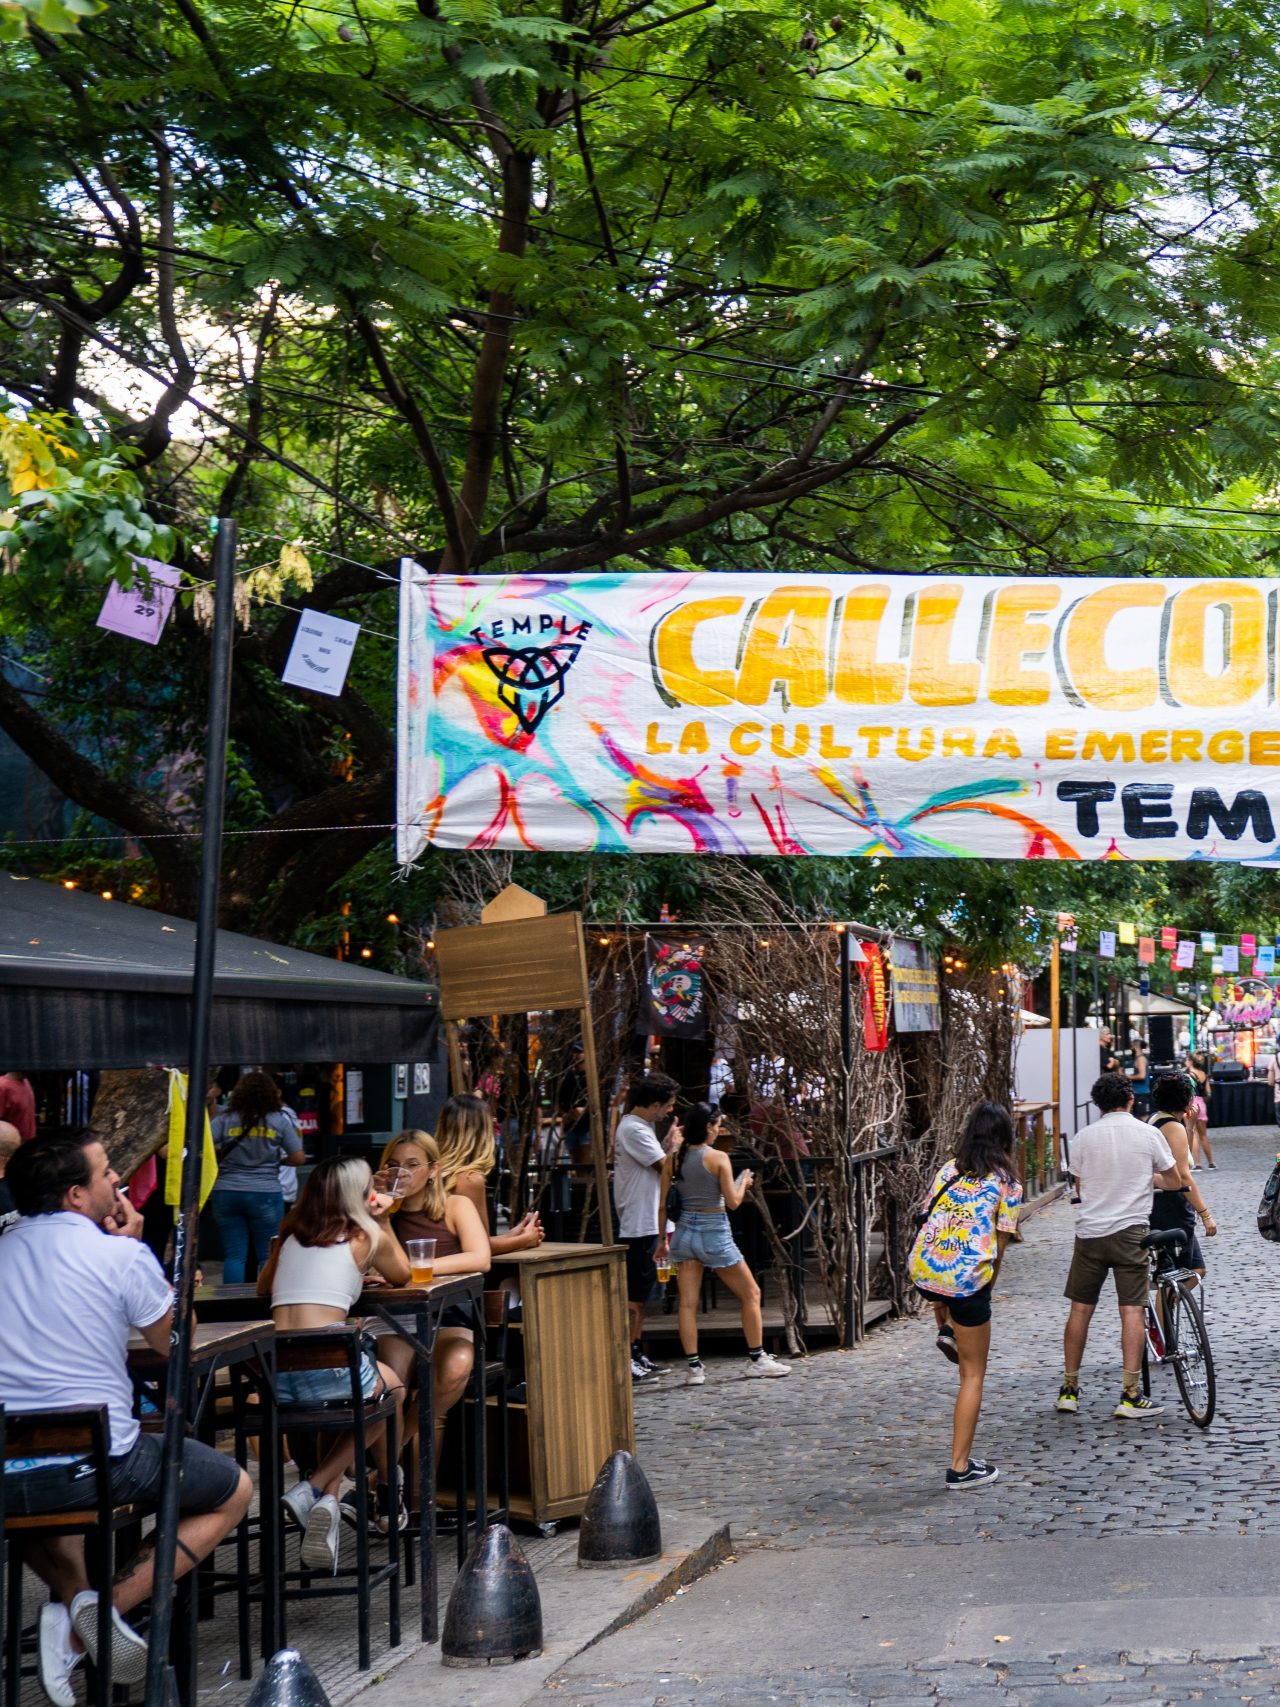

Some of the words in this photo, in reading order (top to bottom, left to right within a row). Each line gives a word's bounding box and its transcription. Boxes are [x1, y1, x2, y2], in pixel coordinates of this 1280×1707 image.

[133, 605, 155, 617] 29
[469, 614, 594, 646] TEMPLE
[646, 721, 711, 757] LA
[728, 721, 1019, 762] CULTURA
